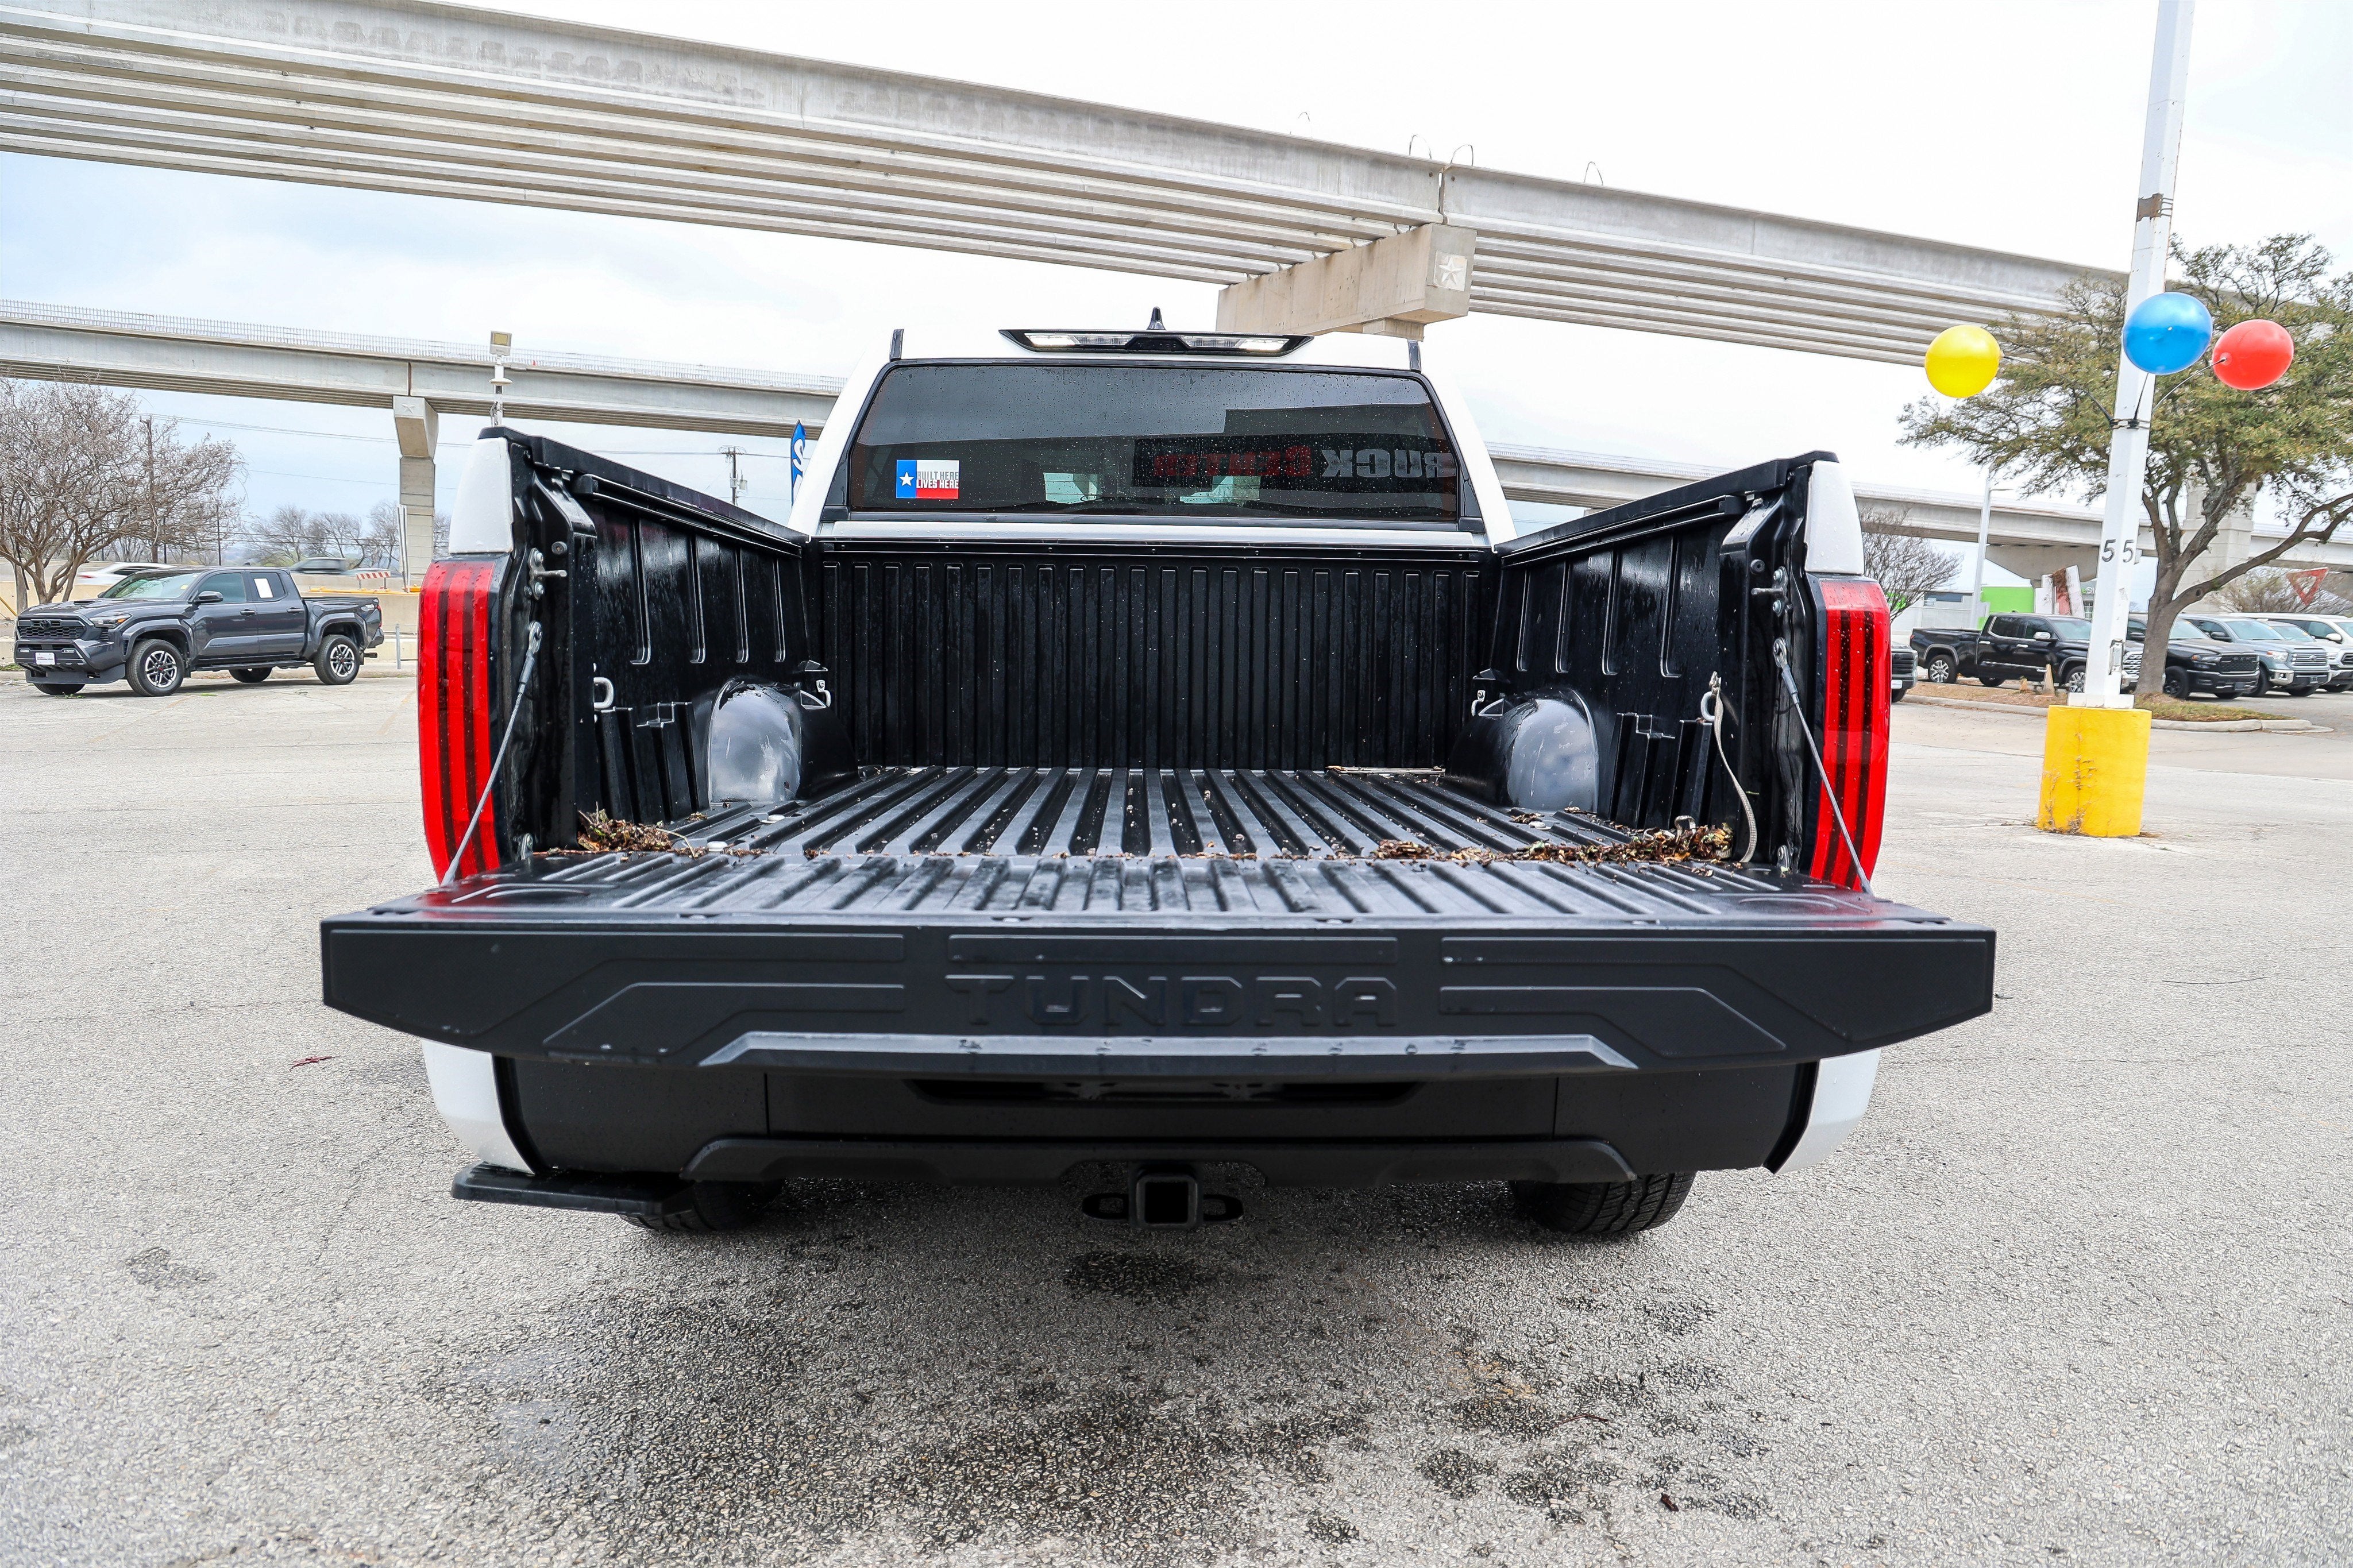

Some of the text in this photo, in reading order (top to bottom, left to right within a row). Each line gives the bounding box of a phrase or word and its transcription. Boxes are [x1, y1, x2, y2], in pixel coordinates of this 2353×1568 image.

[917, 472, 958, 480] BUILT HERE
[917, 480, 958, 488] LIVES HERE
[944, 975, 1397, 1026] TUNDRA
